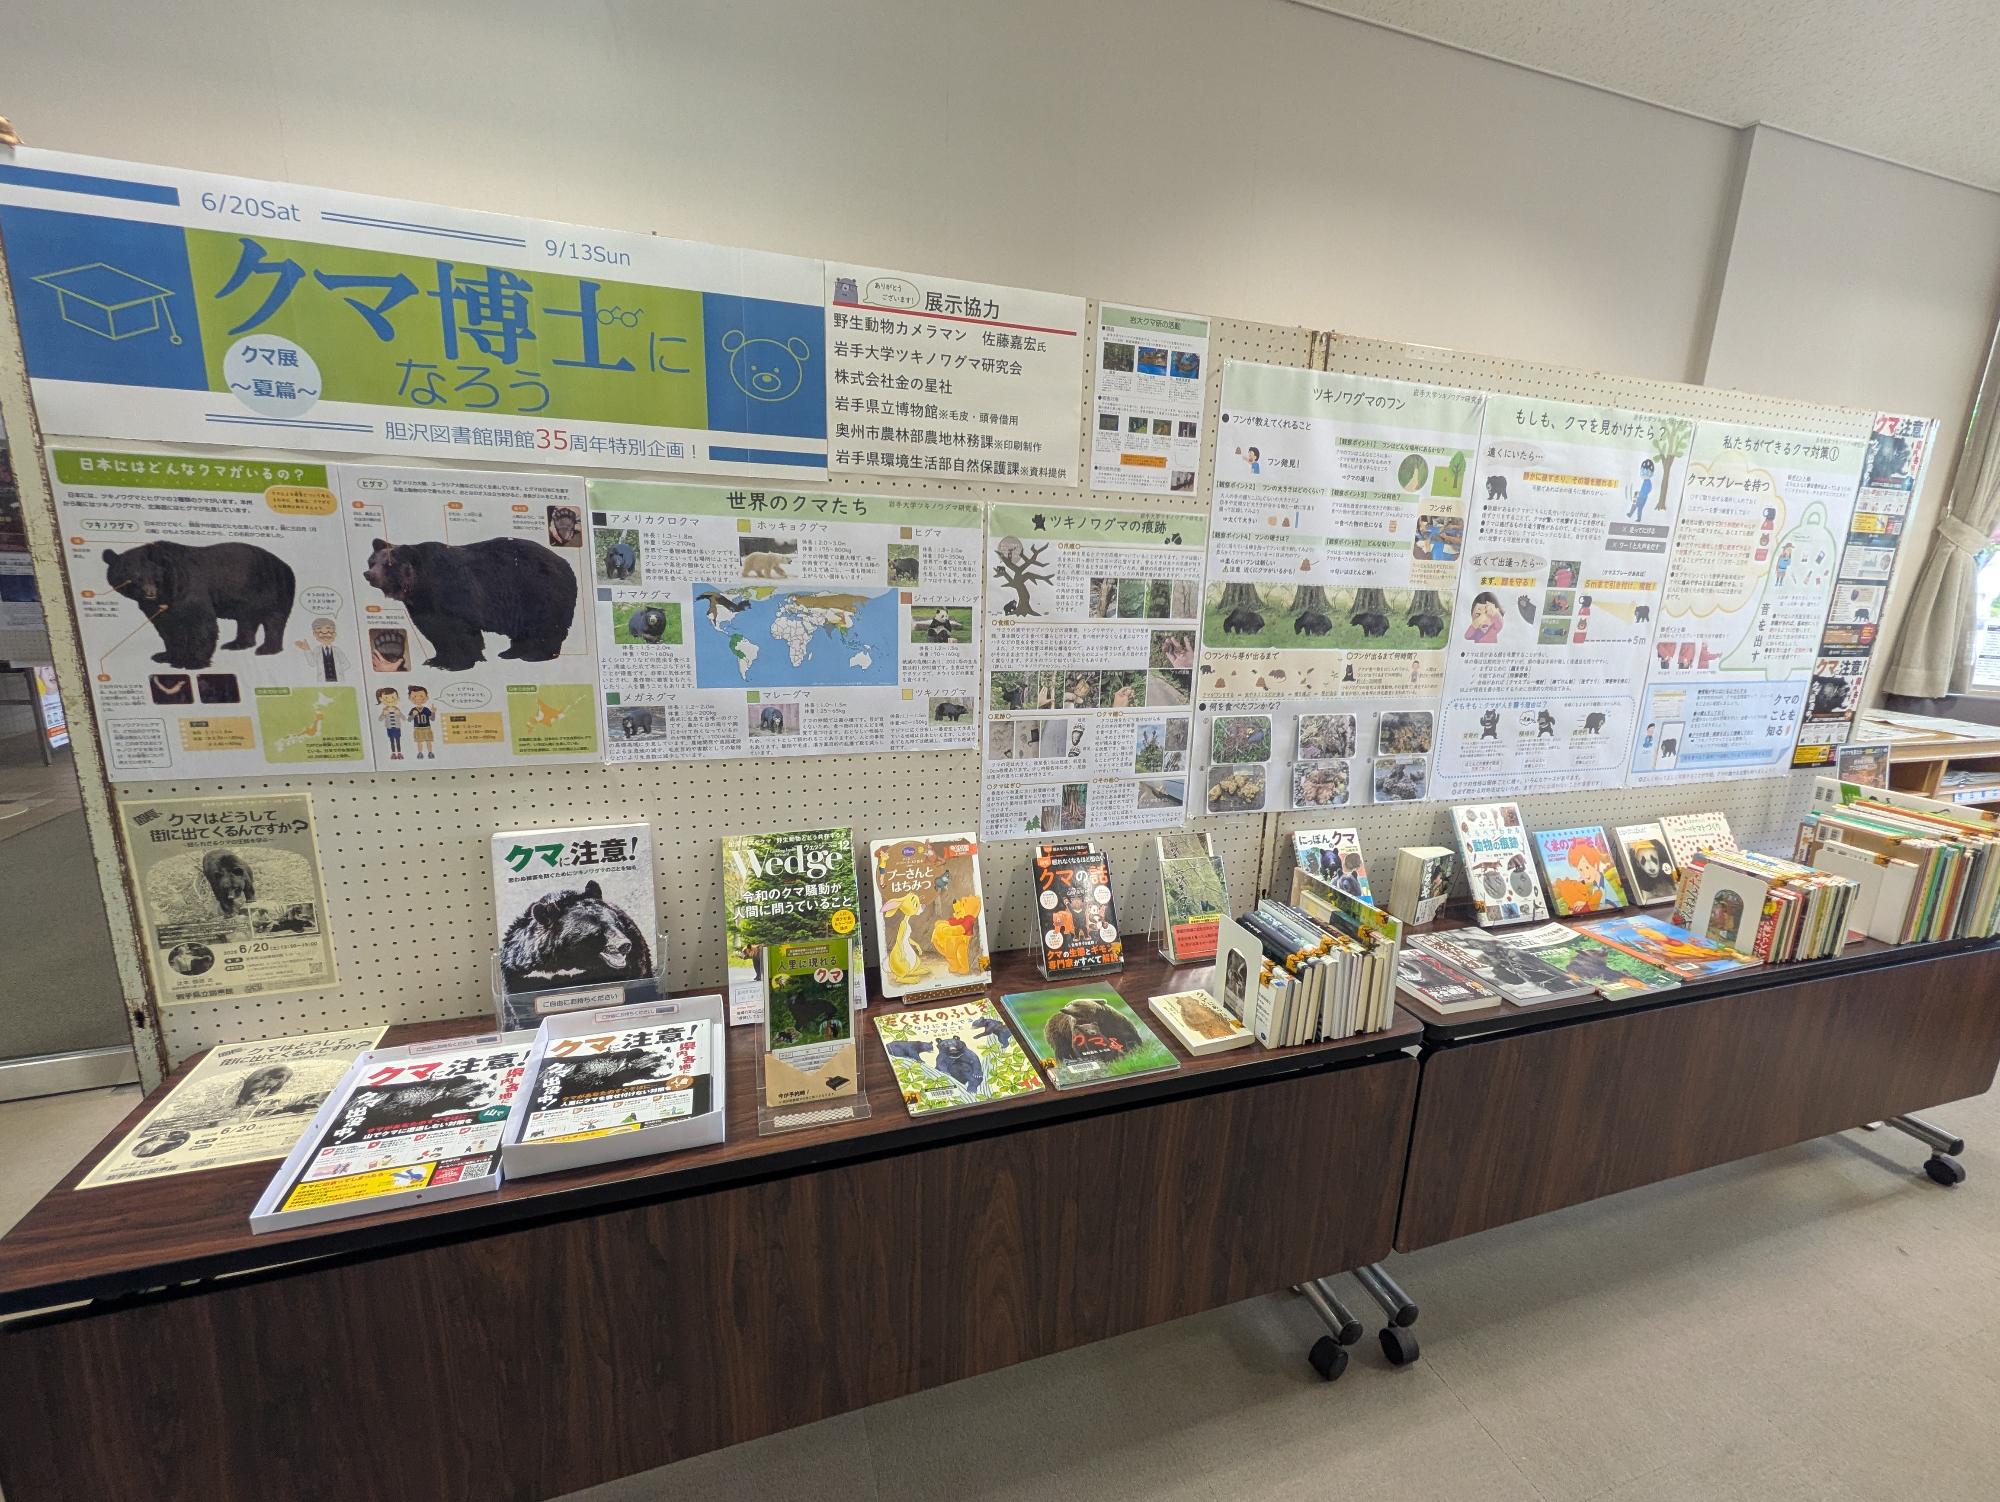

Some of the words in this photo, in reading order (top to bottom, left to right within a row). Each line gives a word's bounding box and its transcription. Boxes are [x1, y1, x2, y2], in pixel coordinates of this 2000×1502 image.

[201, 192, 300, 222] 6/20Sat
[545, 239, 631, 266] 9/13Sun
[874, 282, 902, 293] ありがとう
[215, 237, 690, 374] クマ博士に
[925, 292, 999, 319] 展示協力
[834, 313, 967, 341] 野生動物カメラマン
[982, 331, 1046, 353] 佐藤嘉宏氏
[241, 345, 299, 367] クマ展
[834, 341, 1022, 376] 岩手大学ツキノワグマ研究会
[395, 358, 550, 412] なろう
[835, 368, 952, 394] 株式会社金の星社
[1313, 388, 1406, 411] ツキノワグマのフン
[1233, 415, 1312, 431] フンが教えてくれること
[1516, 409, 1666, 441] もしも、クマを見かけたら？
[1487, 447, 1544, 461] 遠くにいたら…
[1723, 435, 1839, 461] 私たちができるクマ対策①
[80, 457, 305, 481] 日本にはどんなクマがいるの？
[1268, 458, 1300, 468] フン発見！
[362, 480, 383, 488] ヒグマ
[1688, 473, 1770, 492] クマスプレーを持つ
[727, 491, 867, 516] 世界のクマたち
[1429, 504, 1452, 513] フン分析
[85, 520, 134, 530] ツキノワグマ
[610, 514, 699, 527] アメリカクロクマ
[757, 520, 828, 532] ホッキョクグマ
[1050, 515, 1167, 534] ツキノワグマの痕跡
[915, 528, 942, 537] ヒグマ
[617, 590, 671, 599] ナマケグマ
[1633, 636, 1646, 645] 5m
[1751, 603, 1770, 663] 音を出す
[1352, 652, 1417, 660] フンが出るまで何時間？
[624, 693, 676, 701] メガネグマ
[764, 690, 811, 698] マレーグマ
[915, 689, 967, 697] ツキノワグマ
[1773, 695, 1799, 705] クマの
[1210, 702, 1280, 711] 何を食べたフンかな？
[1770, 710, 1796, 722] ことを
[168, 810, 277, 827] クマはどうして
[150, 820, 308, 843] 街に出てくるんですか？
[505, 836, 638, 873] クマに注意！
[838, 841, 850, 850] 12
[729, 845, 843, 880] Wedge
[887, 867, 934, 881] プーさんと
[1040, 864, 1108, 890] クマの話
[742, 882, 842, 903] 令和のクマ騒動が
[892, 880, 932, 893] はちみつ
[732, 897, 852, 920] 人間に問うていること
[239, 943, 269, 953] 6/20
[778, 957, 837, 972] 人里に現れる
[815, 968, 842, 983] クマ
[542, 993, 618, 1008] ご自由にお持ちください
[885, 1003, 988, 1026] たくさんのふしぎ
[551, 1025, 698, 1057] クマに注意！
[676, 1041, 696, 1074] 県内各地に
[368, 1050, 532, 1086] クマに注意！
[538, 1063, 566, 1110] クマ出没中！
[334, 1091, 379, 1145] クマ出没中！
[220, 1123, 257, 1135] 6/20
